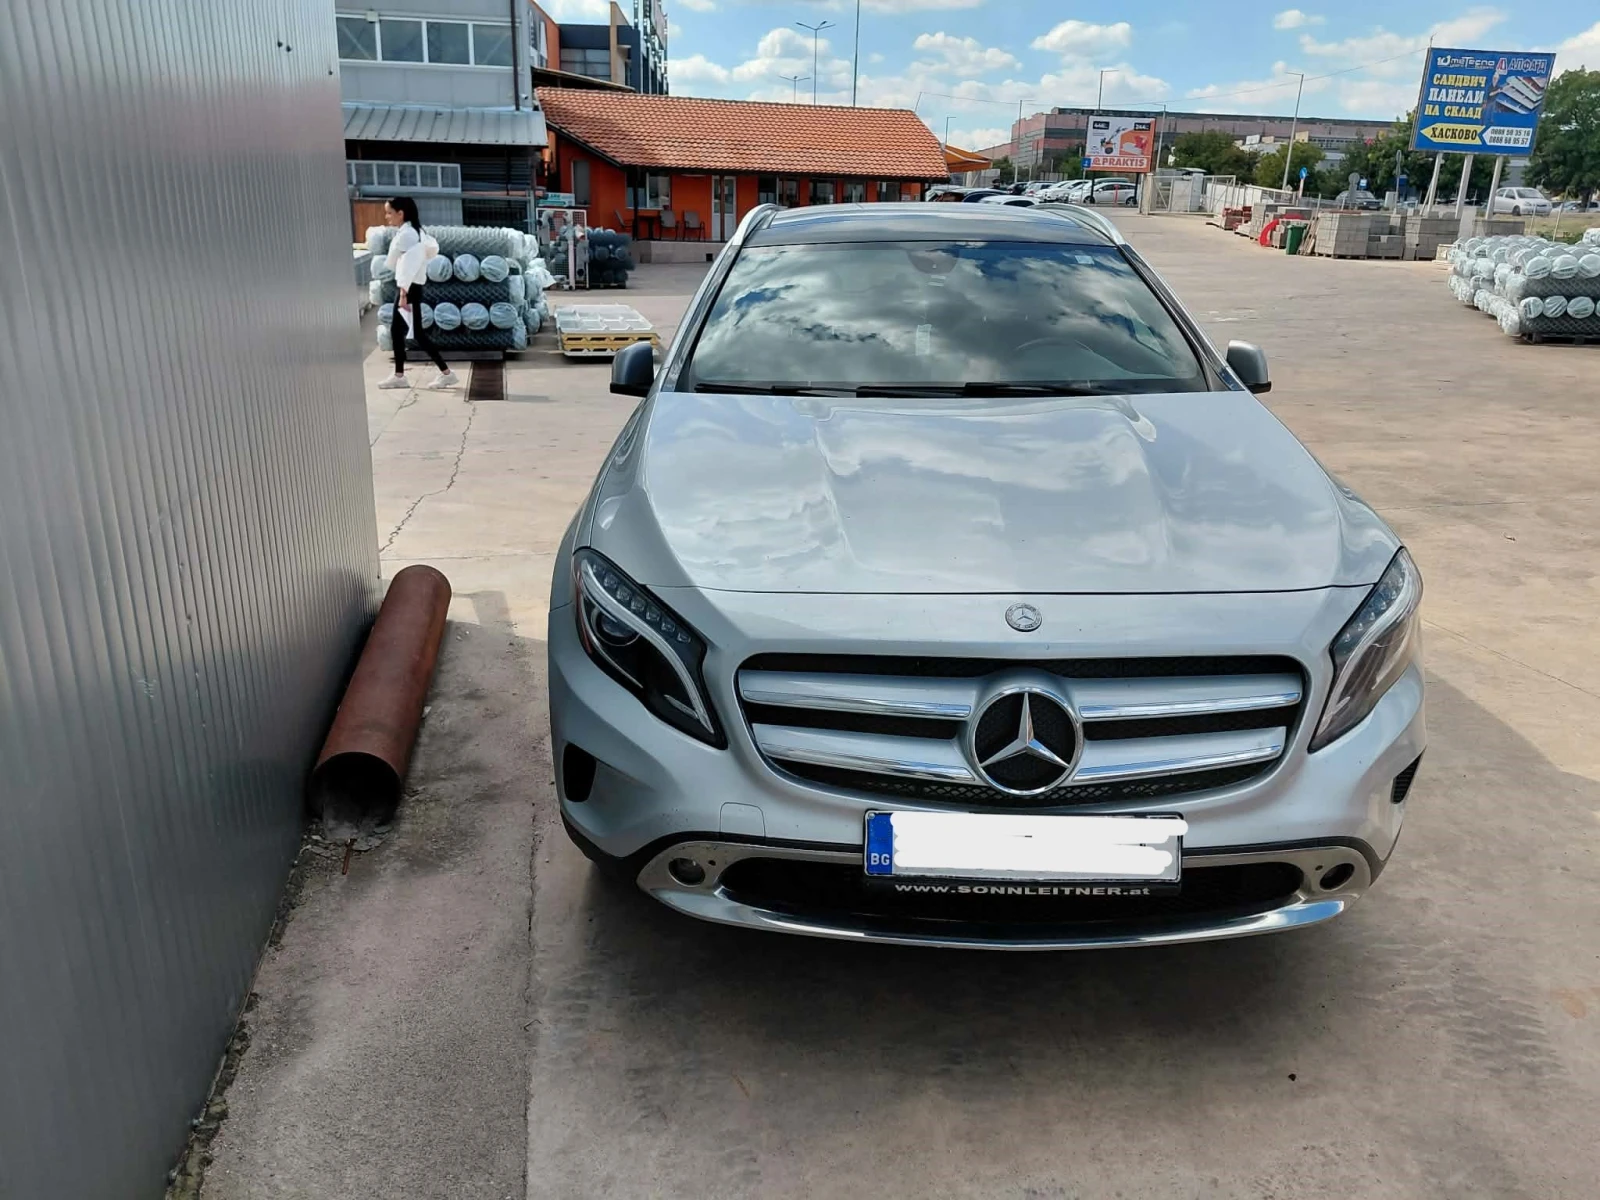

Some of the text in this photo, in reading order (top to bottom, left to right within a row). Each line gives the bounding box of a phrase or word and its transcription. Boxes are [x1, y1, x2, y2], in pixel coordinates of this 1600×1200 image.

[1433, 74, 1487, 88] САНДВИЧ
[1428, 88, 1485, 104] ПАНЕЛИ
[1424, 104, 1482, 119] НА СКЛАД
[1430, 127, 1478, 141] ХАСКОВО
[1102, 157, 1145, 167] PRAKTIS
[870, 853, 890, 866] BG
[895, 884, 1150, 896] www.SONNLEITNER.at
